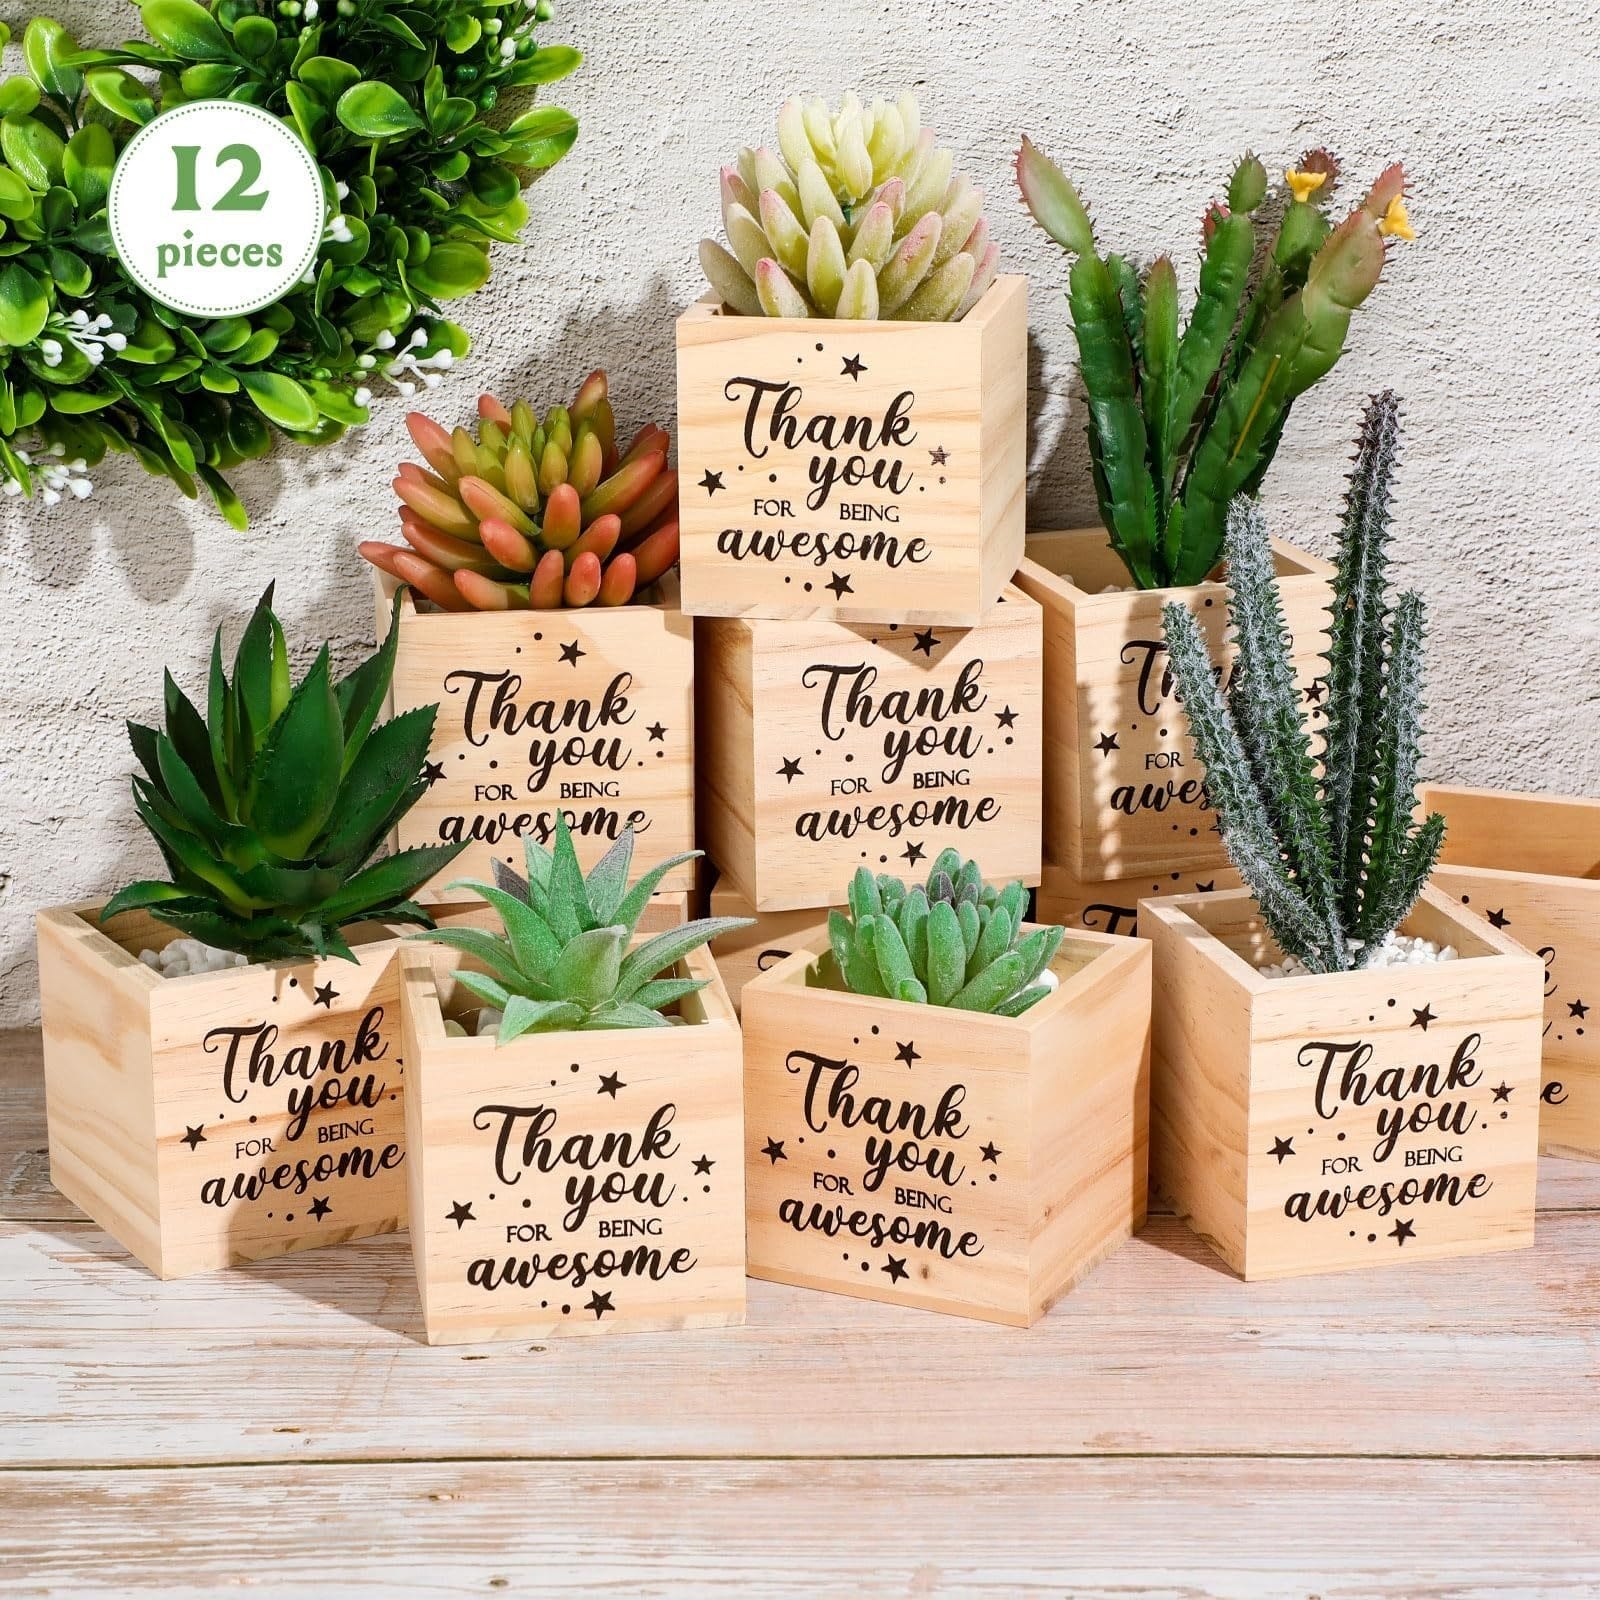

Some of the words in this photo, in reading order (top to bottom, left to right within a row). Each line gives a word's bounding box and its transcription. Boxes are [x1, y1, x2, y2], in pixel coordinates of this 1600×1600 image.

[724, 376, 918, 459] Thank
[754, 499, 796, 517] FOR
[840, 503, 899, 522] BEING
[807, 456, 914, 511] you
[717, 528, 932, 568] awesome
[444, 669, 636, 746] Thank
[802, 658, 987, 741] Thank
[527, 737, 632, 792] you
[882, 726, 983, 784] you
[1145, 752, 1184, 770] FOR
[475, 785, 517, 801] FOR
[560, 782, 620, 799] BEING
[831, 778, 872, 796] FOR
[913, 770, 970, 789] BEING
[796, 796, 1001, 842] awesome
[203, 1006, 389, 1103] Thank
[1297, 1033, 1483, 1120] Thank
[287, 1074, 385, 1141] you
[786, 1050, 969, 1140] Thank
[235, 1138, 277, 1159] FOR
[318, 1119, 374, 1143] BEING
[473, 1103, 681, 1185] Thank
[1373, 1101, 1477, 1163] you
[201, 1144, 406, 1207] awesome
[863, 1136, 965, 1192] you
[1322, 1157, 1363, 1175] FOR
[1405, 1146, 1462, 1167] BEING
[563, 1172, 676, 1232] you
[813, 1172, 854, 1196] FOR
[895, 1187, 952, 1214] BEING
[1284, 1173, 1493, 1222] awesome
[507, 1224, 552, 1242] FOR
[599, 1218, 662, 1238] BEING
[779, 1199, 984, 1259] awesome
[467, 1245, 698, 1290] awesome
